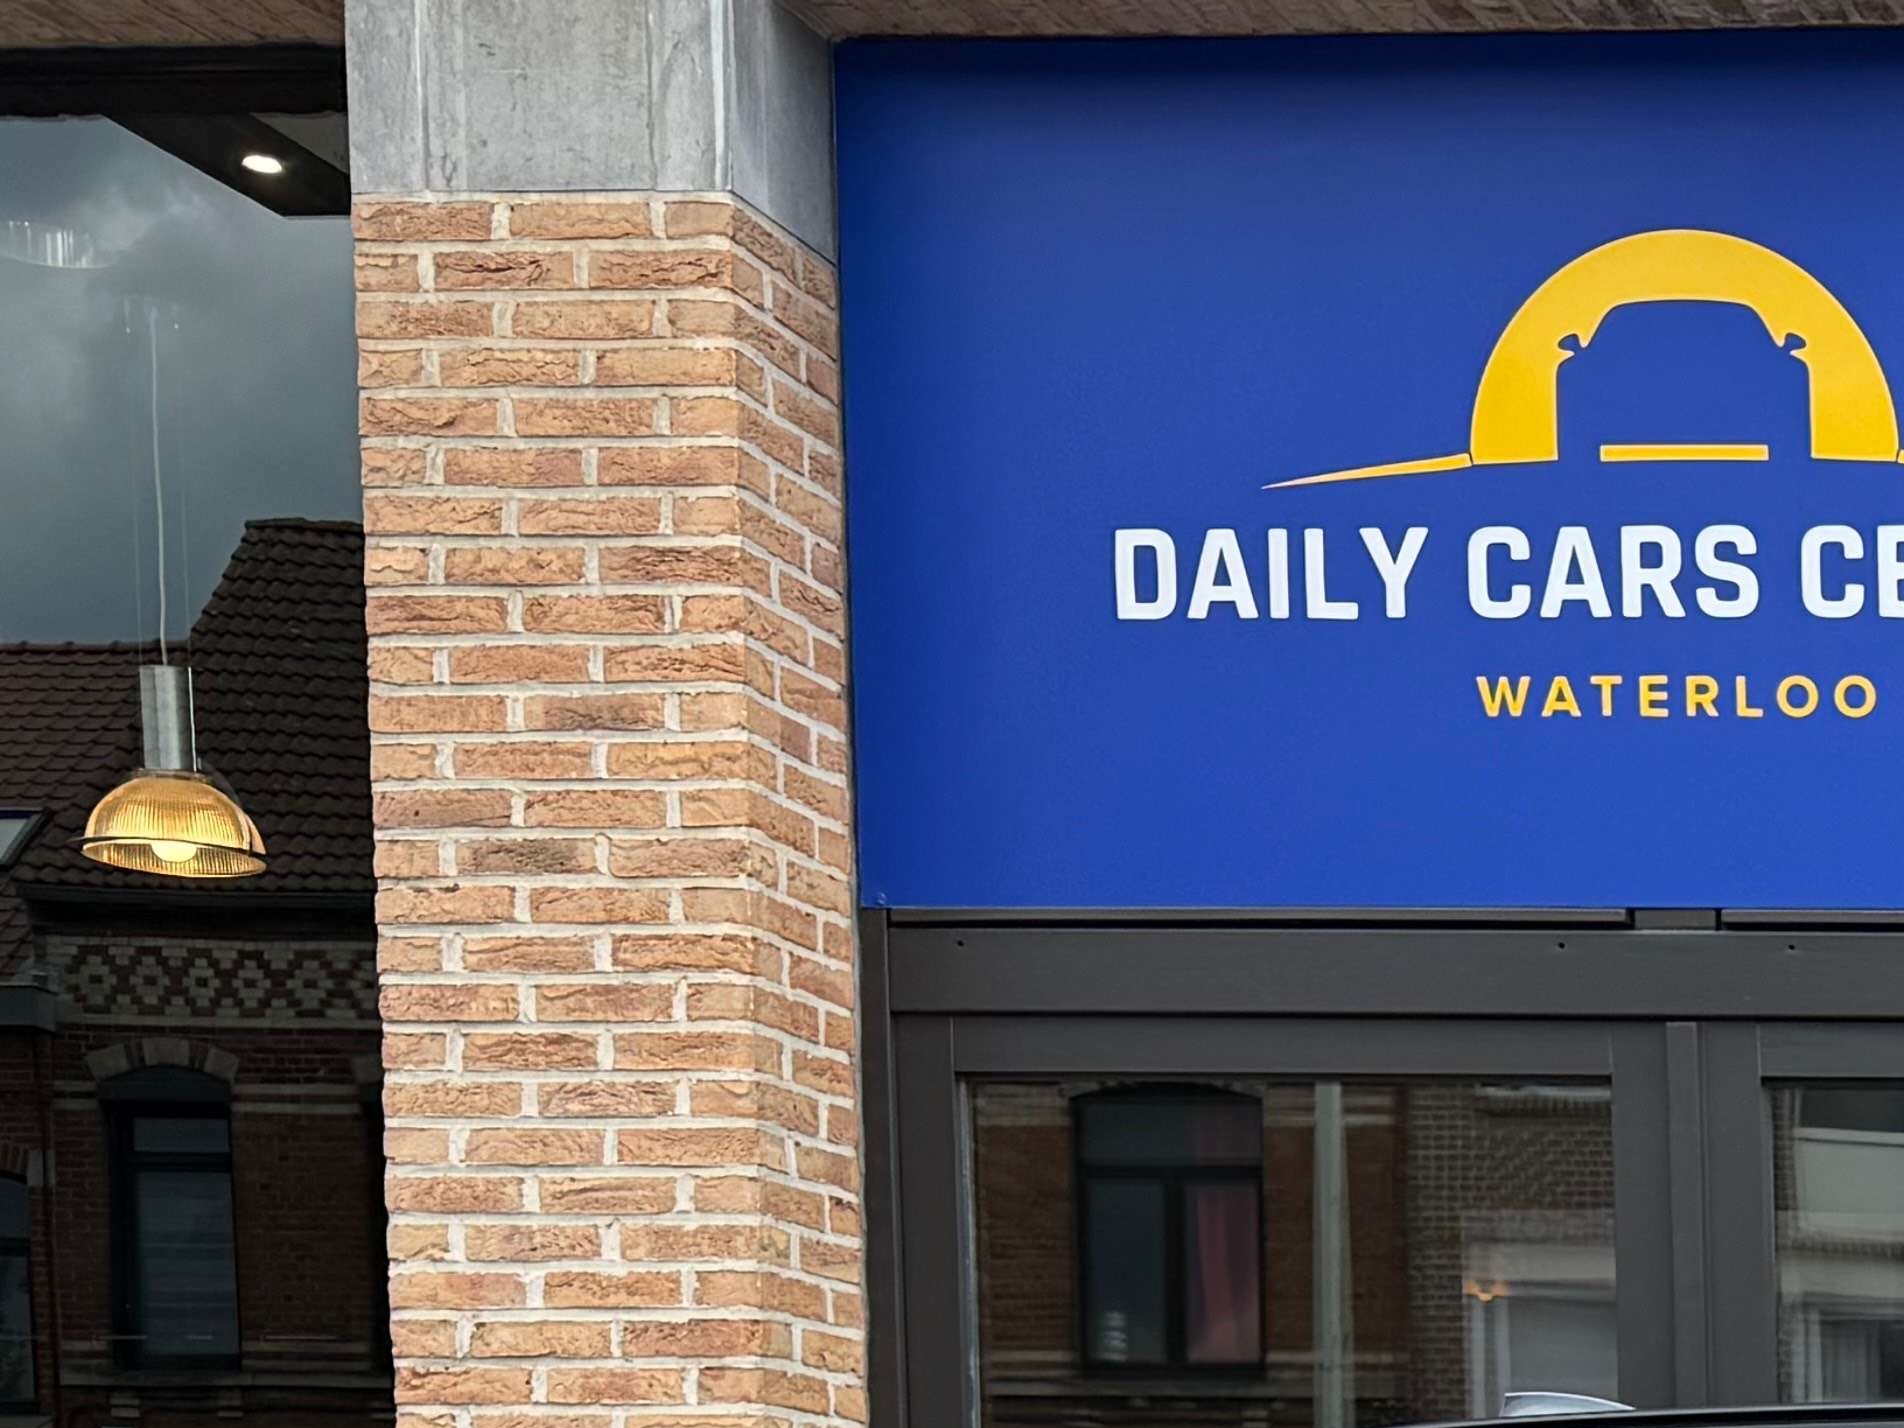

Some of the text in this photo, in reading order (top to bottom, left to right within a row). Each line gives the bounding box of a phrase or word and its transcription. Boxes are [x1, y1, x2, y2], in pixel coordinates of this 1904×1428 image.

[1114, 527, 1428, 620] DAILY
[1467, 524, 1759, 619] CARS
[1475, 673, 1878, 718] WATERLOO
